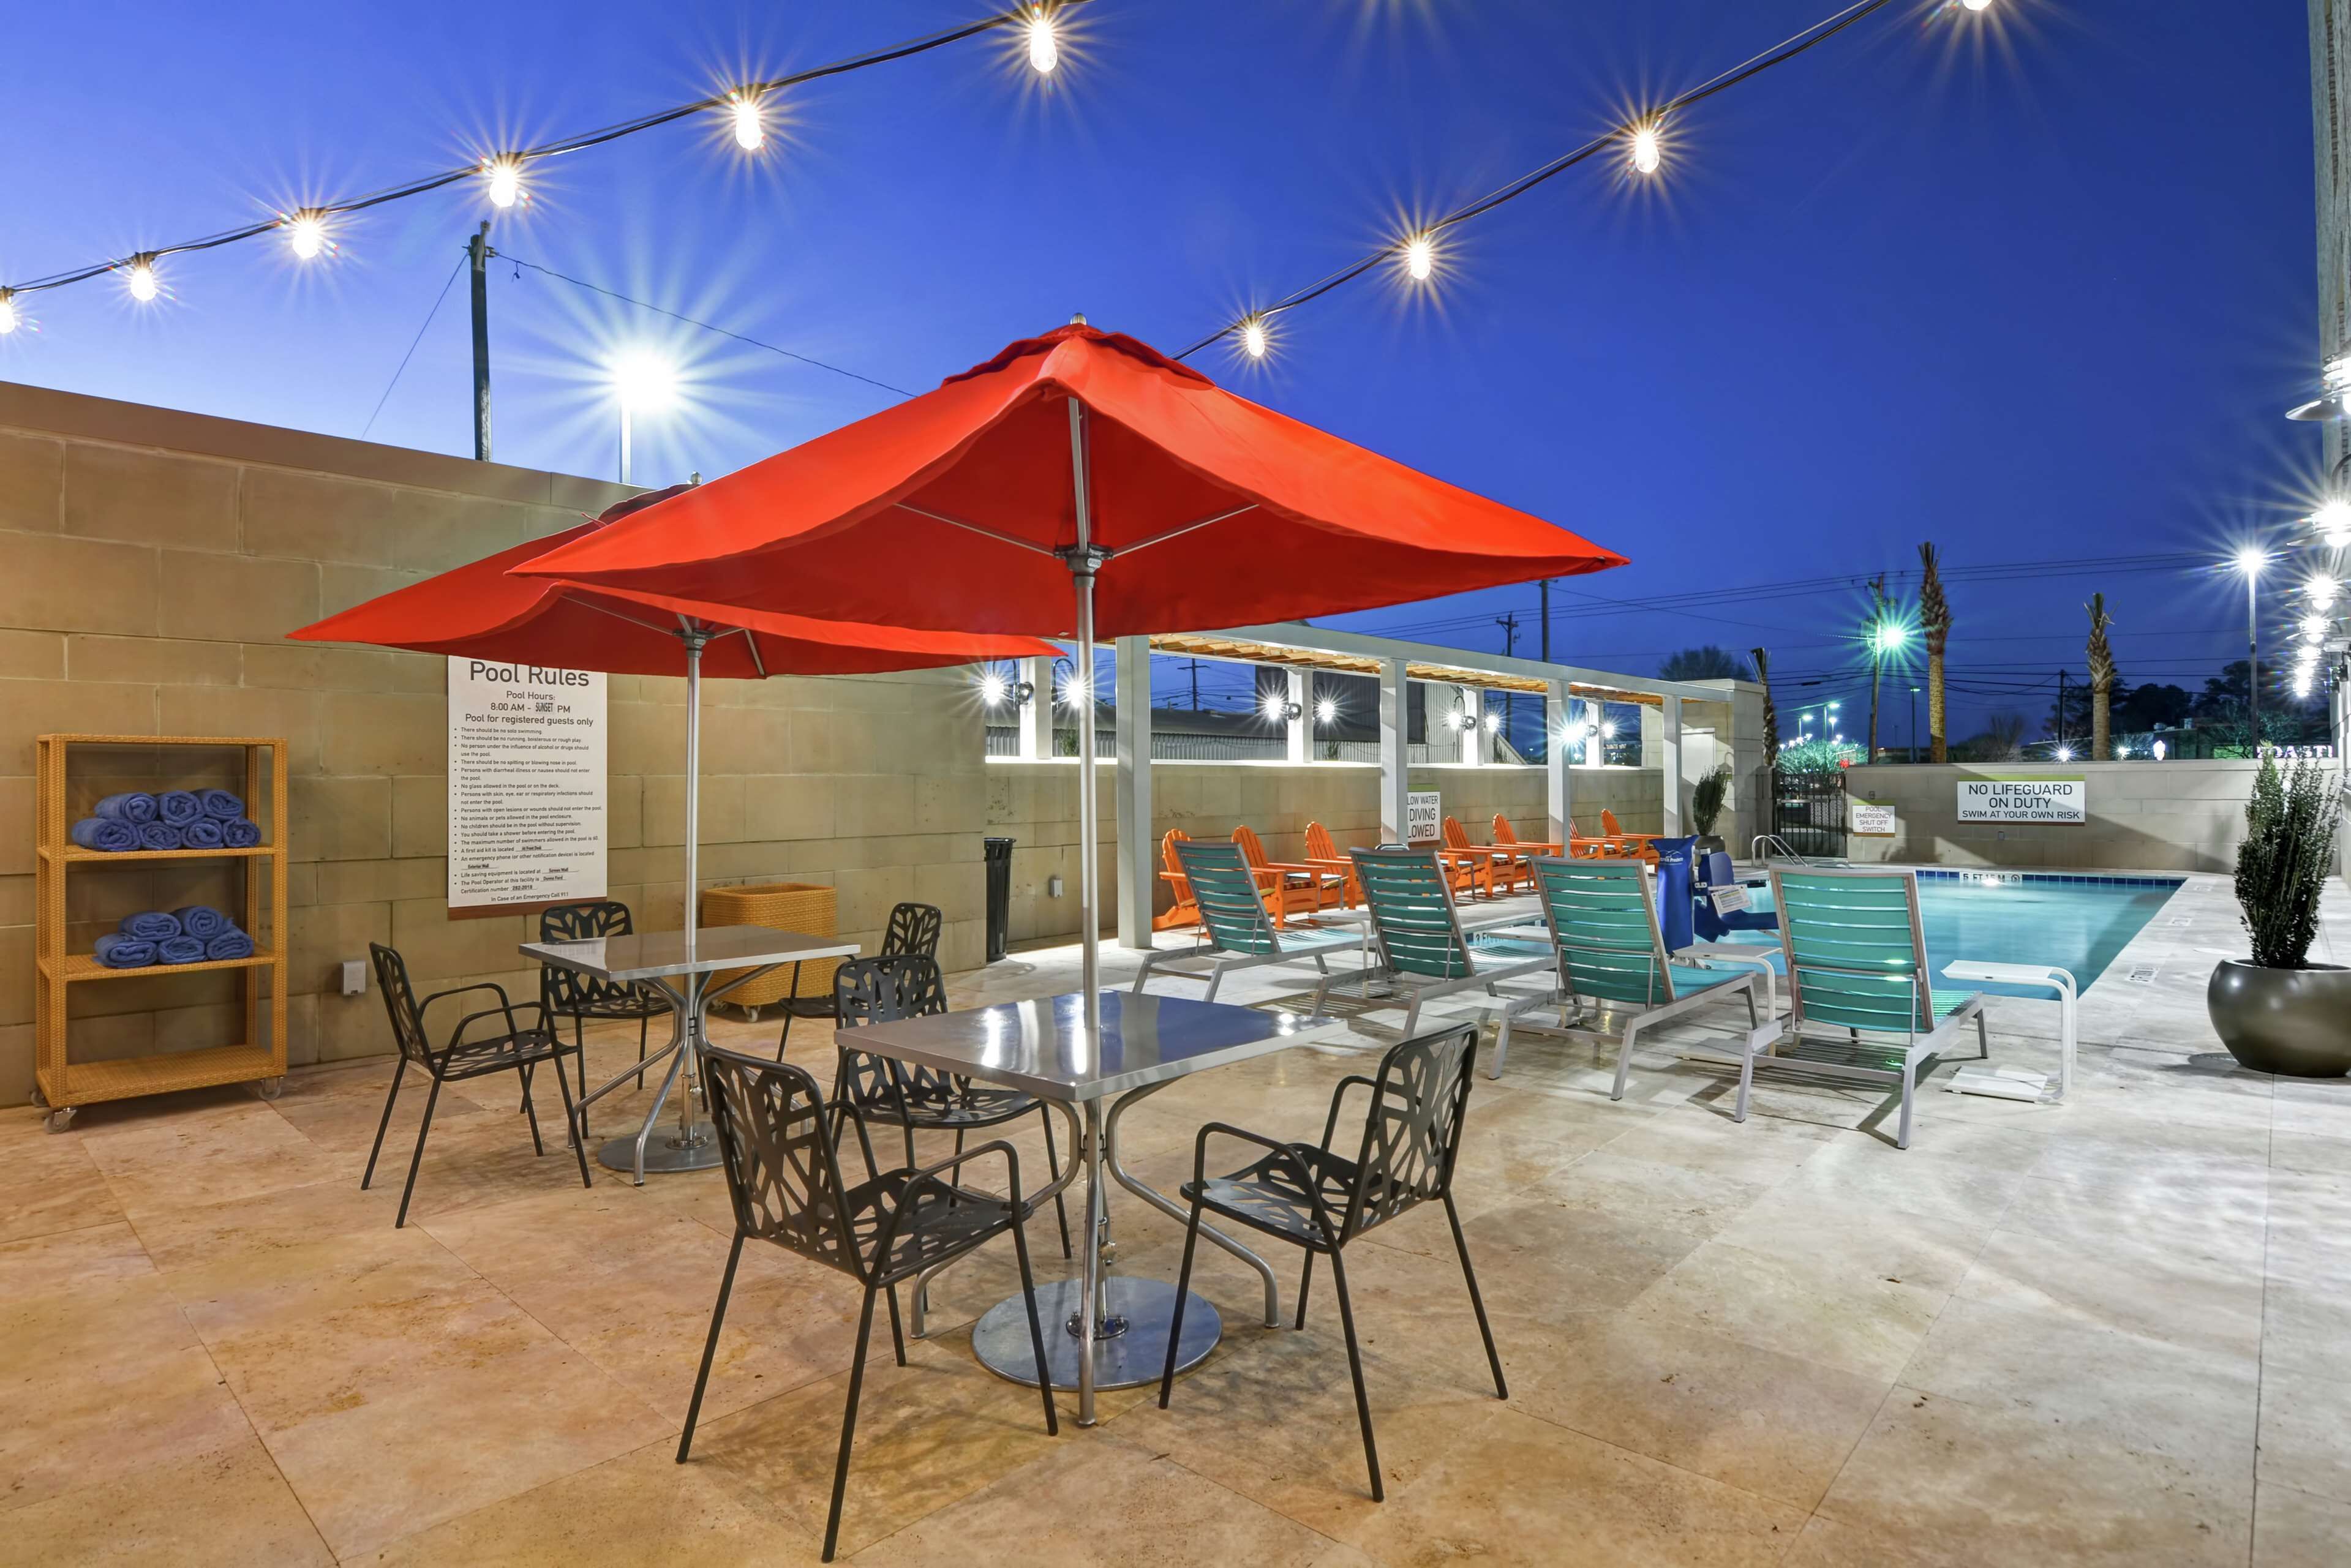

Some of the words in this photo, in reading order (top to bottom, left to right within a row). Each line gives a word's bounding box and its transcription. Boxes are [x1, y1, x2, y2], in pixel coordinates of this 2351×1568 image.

[470, 661, 519, 683] Pool
[529, 666, 589, 686] Rules
[506, 691, 525, 699] Pool
[528, 692, 555, 700] Hours:
[535, 702, 554, 712] SUNSET
[465, 713, 484, 722] Pool
[502, 715, 544, 725] registered
[547, 718, 574, 726] guests
[1969, 784, 1988, 795] NO
[1993, 784, 2072, 795] LIFEGUARD
[1421, 796, 1438, 805] WATER
[1989, 797, 2008, 808] ON
[2014, 798, 2051, 808] DUTY
[1410, 808, 1435, 822] DIVING
